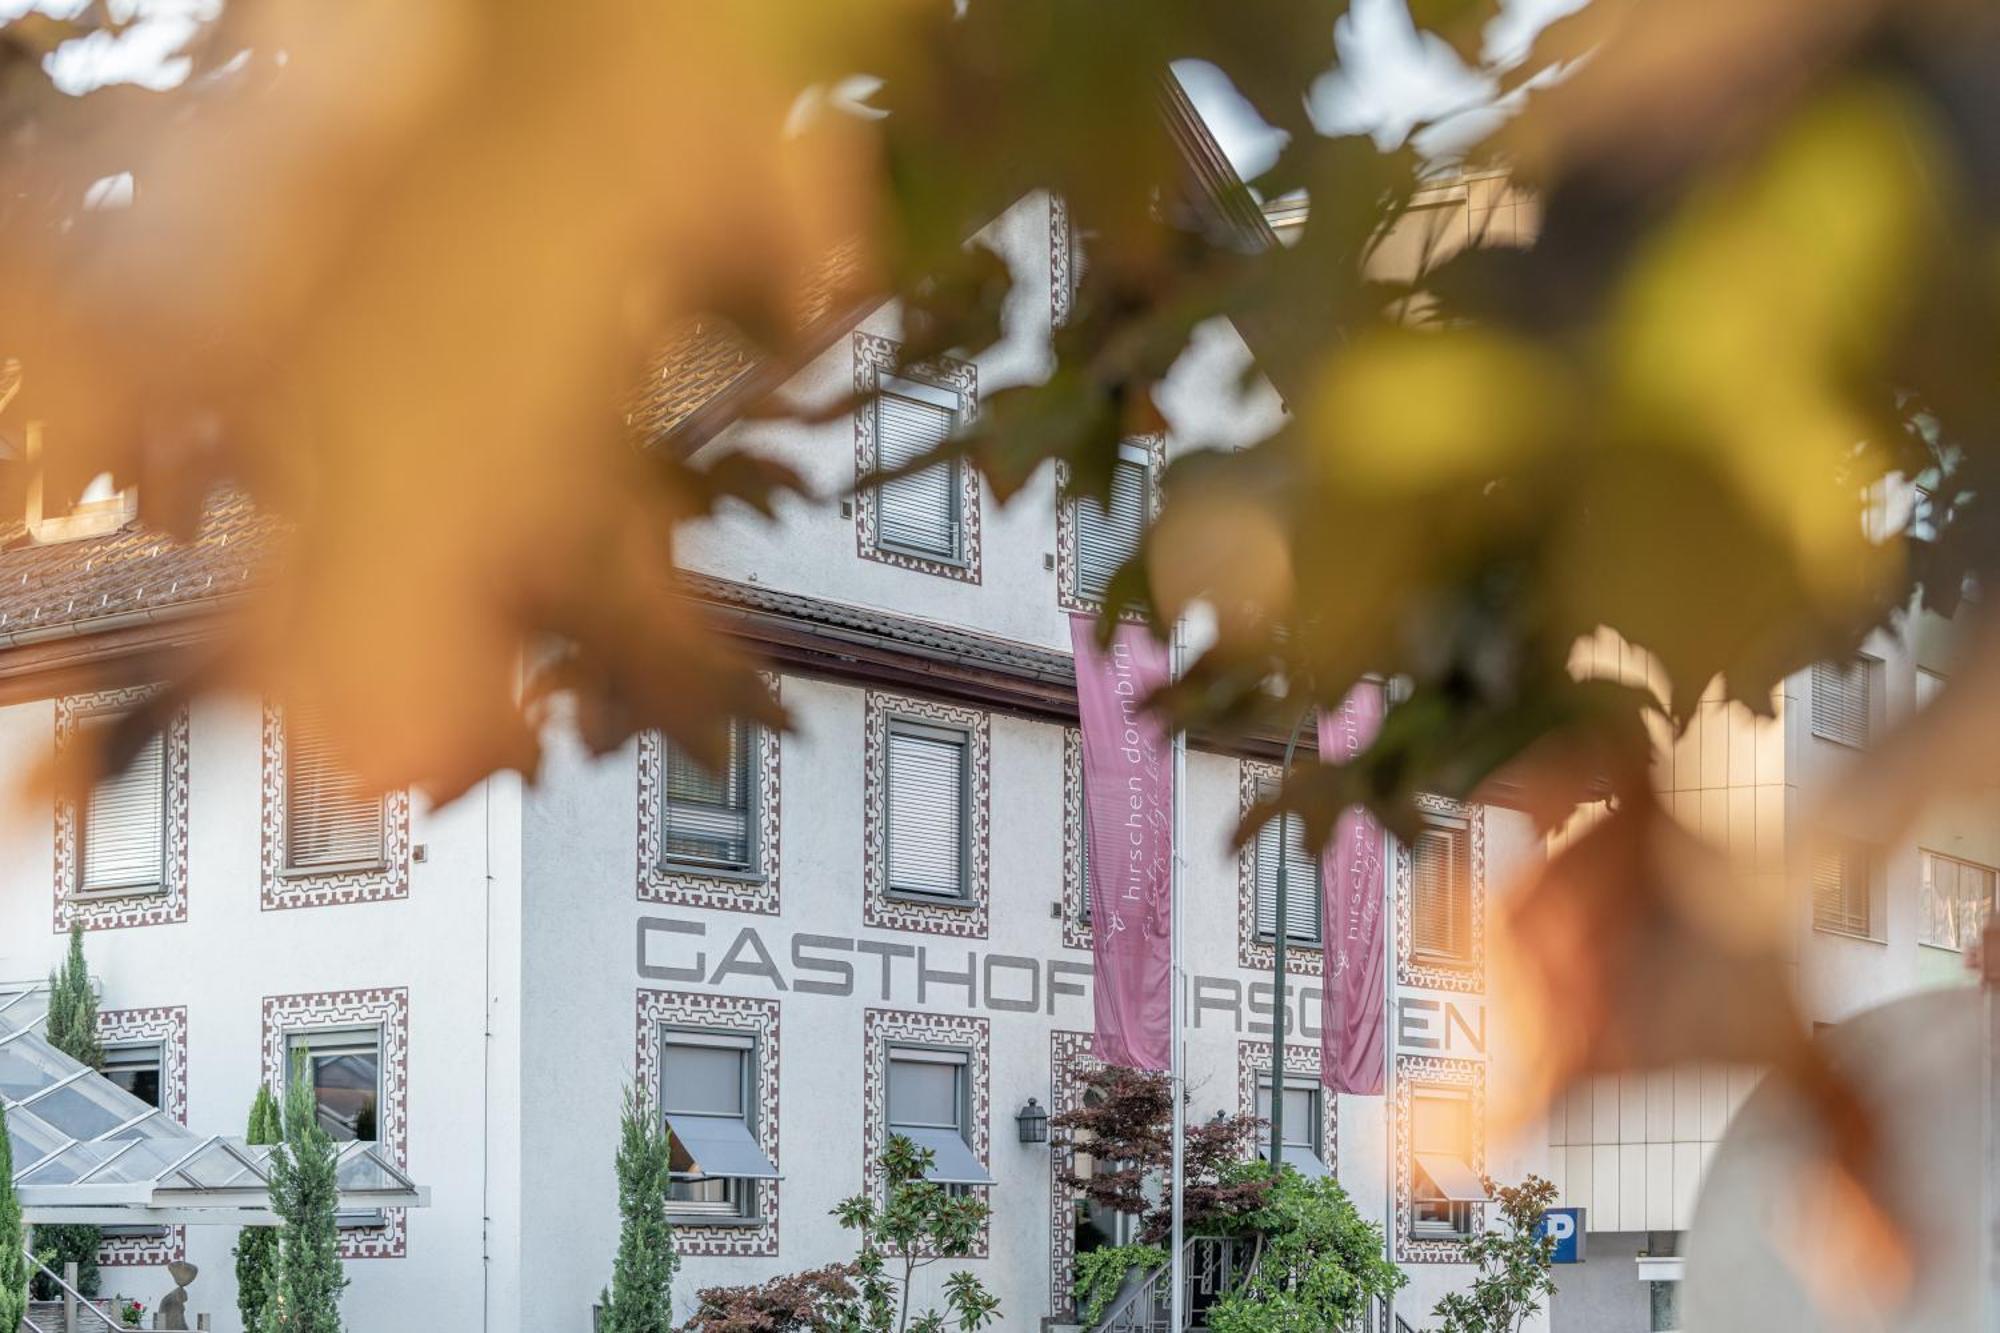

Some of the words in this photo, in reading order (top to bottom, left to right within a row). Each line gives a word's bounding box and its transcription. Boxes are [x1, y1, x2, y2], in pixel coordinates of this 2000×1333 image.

[1113, 643, 1142, 764] dornbirn
[1121, 776, 1143, 900] hirschen
[1347, 825, 1366, 940] hirschen
[636, 916, 1095, 1016] GASTHOF
[1547, 1213, 1575, 1251] P
